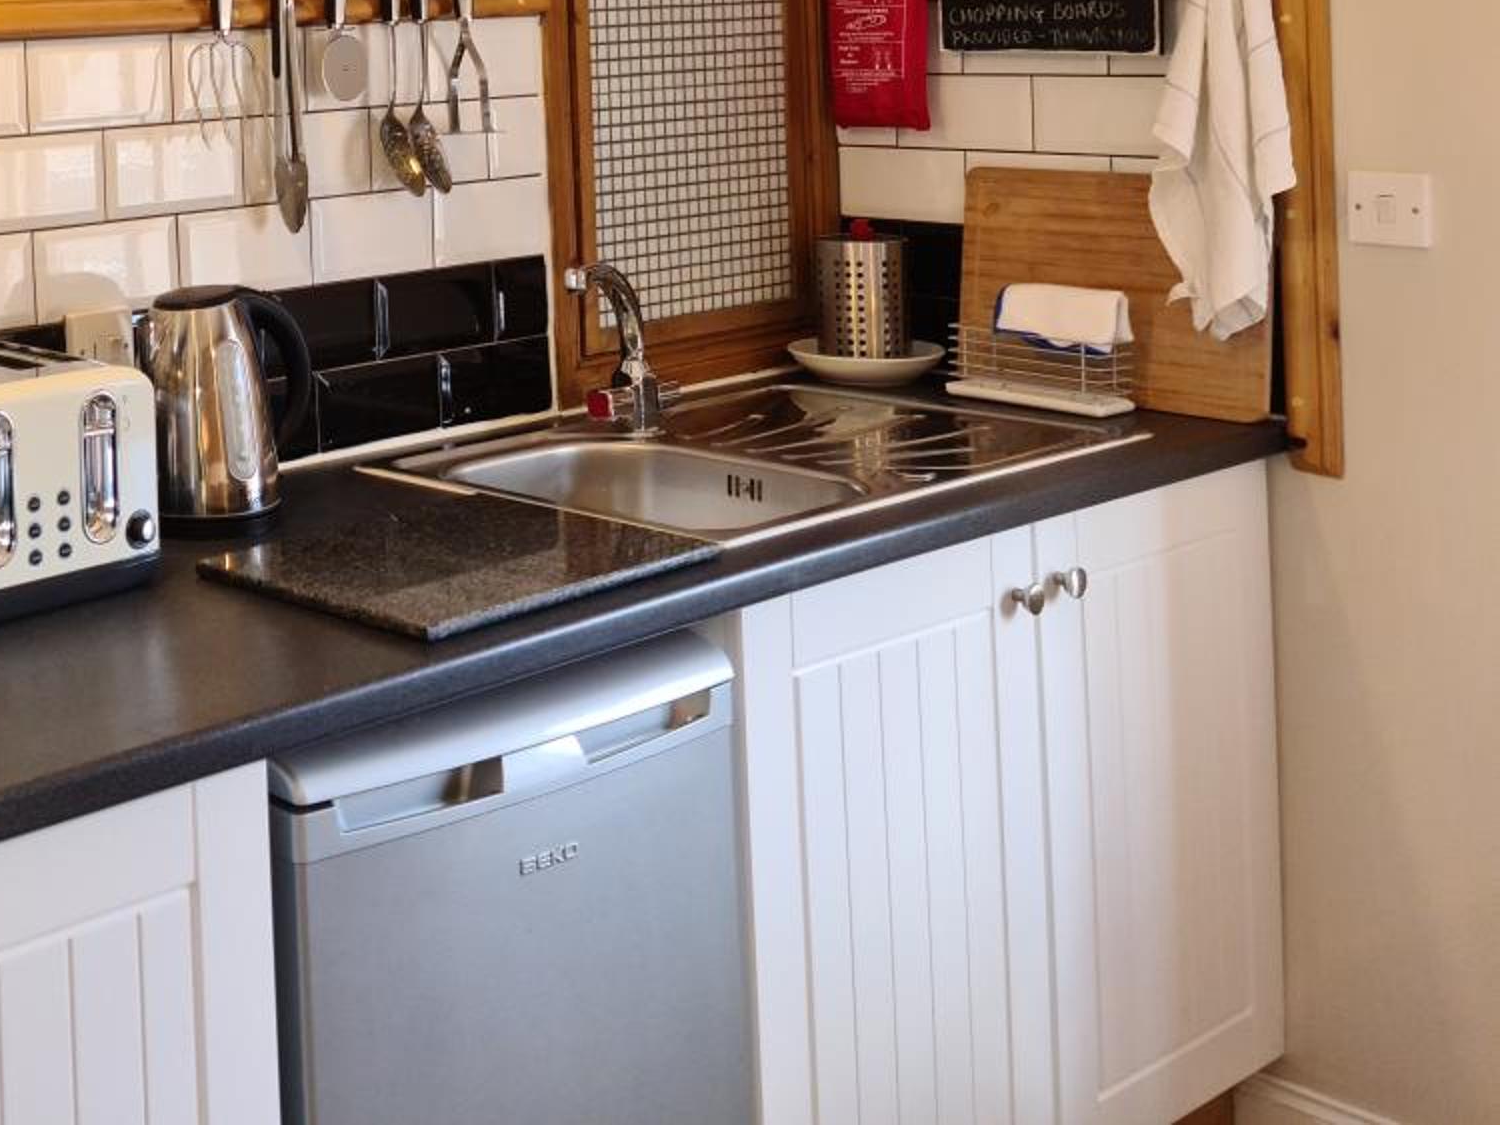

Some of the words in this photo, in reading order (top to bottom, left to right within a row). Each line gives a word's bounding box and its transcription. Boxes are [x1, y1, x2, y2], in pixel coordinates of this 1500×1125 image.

[950, 1, 1045, 25] CHOPPING
[1052, 0, 1126, 21] BOARDS
[518, 842, 580, 876] BEKO
